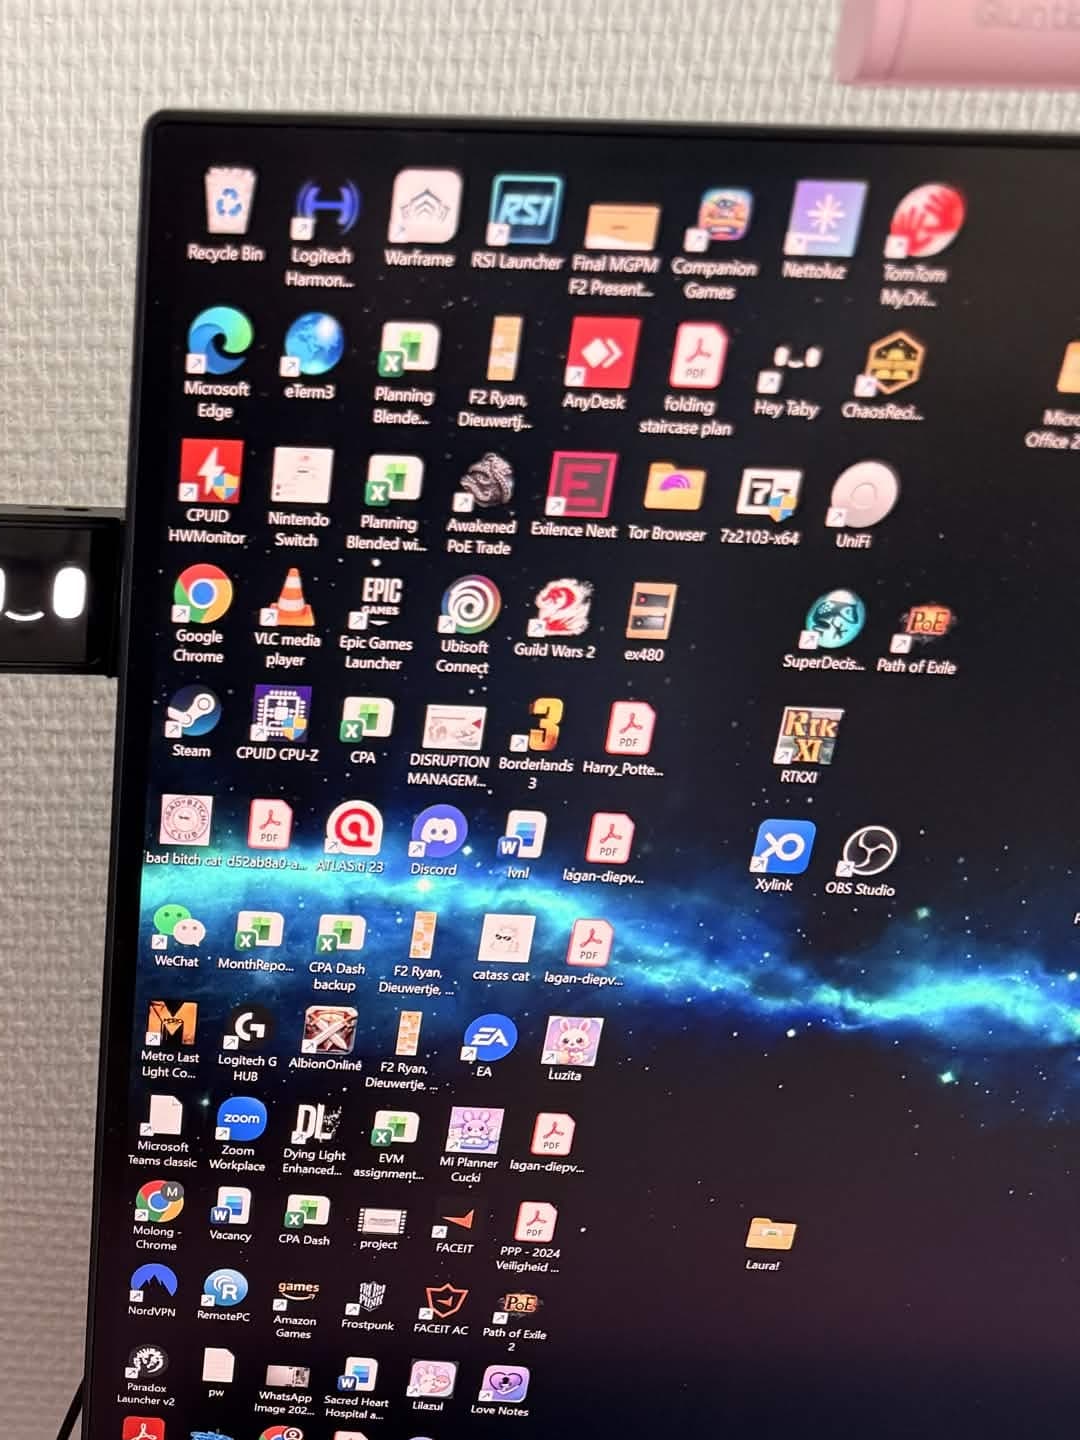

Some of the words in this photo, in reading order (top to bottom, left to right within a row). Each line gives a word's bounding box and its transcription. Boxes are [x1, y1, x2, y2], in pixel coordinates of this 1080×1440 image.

[500, 195, 552, 224] RSI
[187, 244, 239, 263] Recycle
[242, 246, 265, 260] Bin
[291, 248, 353, 265] Logitech
[384, 249, 455, 266] Warframe
[471, 252, 496, 267] RSI
[500, 254, 564, 269] Launcher
[572, 255, 605, 270] Final
[609, 256, 660, 273] MGPM
[671, 257, 759, 278] Companion
[883, 264, 948, 282] TomTom
[684, 281, 737, 299] Games
[184, 381, 250, 396] Microsoft
[285, 384, 335, 398] eTerm3
[375, 386, 434, 405] Planning
[562, 394, 627, 410] AnyDesk
[197, 403, 234, 419] Edge
[664, 396, 715, 415] folding
[754, 400, 782, 418] Hey
[785, 401, 819, 418] Taby
[639, 420, 698, 434] staircase
[700, 421, 733, 437] plan
[1025, 430, 1069, 449] Office
[186, 509, 230, 522] CPUID
[268, 512, 331, 526] Nintendo
[360, 515, 418, 531] Planning
[447, 518, 517, 534] Awakened
[168, 529, 246, 544] HWMonitor
[531, 522, 583, 537] Exilence
[585, 524, 617, 538] Next
[628, 525, 649, 539] Tor
[652, 525, 707, 541] Browser
[720, 529, 799, 544] 7z2103-x64
[275, 532, 319, 546] Switch
[346, 535, 400, 550] Blended
[835, 533, 872, 548] UniFi
[447, 540, 472, 553] PoE
[476, 540, 511, 554] Trade
[362, 577, 402, 602] EPIC
[176, 630, 223, 644] Google
[255, 632, 280, 644] VLC
[281, 634, 321, 646] media
[340, 636, 367, 649] Epic
[369, 637, 413, 651] Games
[441, 639, 489, 653] Ubisoft
[514, 643, 547, 656] Guild
[552, 645, 584, 657] Wars
[173, 649, 224, 662] Chrome
[265, 652, 306, 667] player
[625, 648, 664, 660] ex480
[345, 655, 402, 670] Launcher
[436, 660, 489, 673] Connect
[876, 657, 906, 672] Path
[926, 661, 957, 674] Exile
[172, 744, 211, 756] Steam
[236, 747, 276, 759] CPUID
[279, 748, 319, 761] CPU-Z
[350, 751, 376, 763] CPA
[410, 753, 490, 768] DISRUPTION
[500, 757, 574, 771] Borderlands
[781, 770, 818, 782] RTKXI
[146, 852, 169, 864] bad
[172, 853, 201, 864] bitch
[411, 862, 457, 875] Discord
[755, 878, 793, 892] Xylink
[825, 882, 852, 894] OBS
[855, 884, 895, 896] Studio
[154, 955, 199, 966] WeChat
[309, 962, 332, 973] CPA
[336, 963, 365, 974] Dash
[473, 970, 509, 981] catass
[314, 979, 356, 992] backup
[141, 1050, 175, 1061] Metro
[219, 1054, 262, 1066] Logitech
[142, 1066, 169, 1078] Light
[234, 1071, 258, 1081] HUB
[224, 1113, 259, 1124] zoom
[137, 1141, 189, 1152] Microsoft
[222, 1146, 254, 1156] Zoom
[128, 1155, 160, 1166] Teams
[164, 1155, 197, 1167] classic
[283, 1149, 315, 1161] Dying
[318, 1150, 346, 1161] Light
[379, 1154, 404, 1164] EVM
[210, 1160, 265, 1172] Workplace
[457, 1157, 499, 1169] Planner
[133, 1226, 175, 1237] Molong
[210, 1231, 252, 1242] Vacancy
[136, 1240, 177, 1251] Chrome
[303, 1236, 330, 1246] Dash
[360, 1240, 398, 1251] project
[436, 1243, 474, 1253] FACEIT
[532, 1248, 560, 1259] 2024
[496, 1260, 548, 1272] Veiligheid
[746, 1260, 780, 1271] Laura!
[279, 1282, 319, 1293] games
[505, 1296, 537, 1310] PoE
[128, 1307, 176, 1317] NordVPN
[197, 1311, 250, 1322] RemotePC
[273, 1316, 317, 1327] Amazon
[341, 1320, 394, 1331] Frostpunk
[276, 1329, 312, 1340] Games
[414, 1324, 450, 1335] FACEIT
[483, 1327, 506, 1338] Path
[523, 1329, 547, 1340] Exile
[127, 1383, 167, 1393] Paradox
[117, 1395, 160, 1406] Launcher
[259, 1392, 312, 1403] WhatsApp
[324, 1395, 358, 1406] Sacred
[361, 1397, 389, 1408] Heart
[254, 1404, 286, 1415] Image
[325, 1409, 367, 1420] Hospital
[471, 1404, 496, 1415] Love
[499, 1406, 529, 1417] Notes
